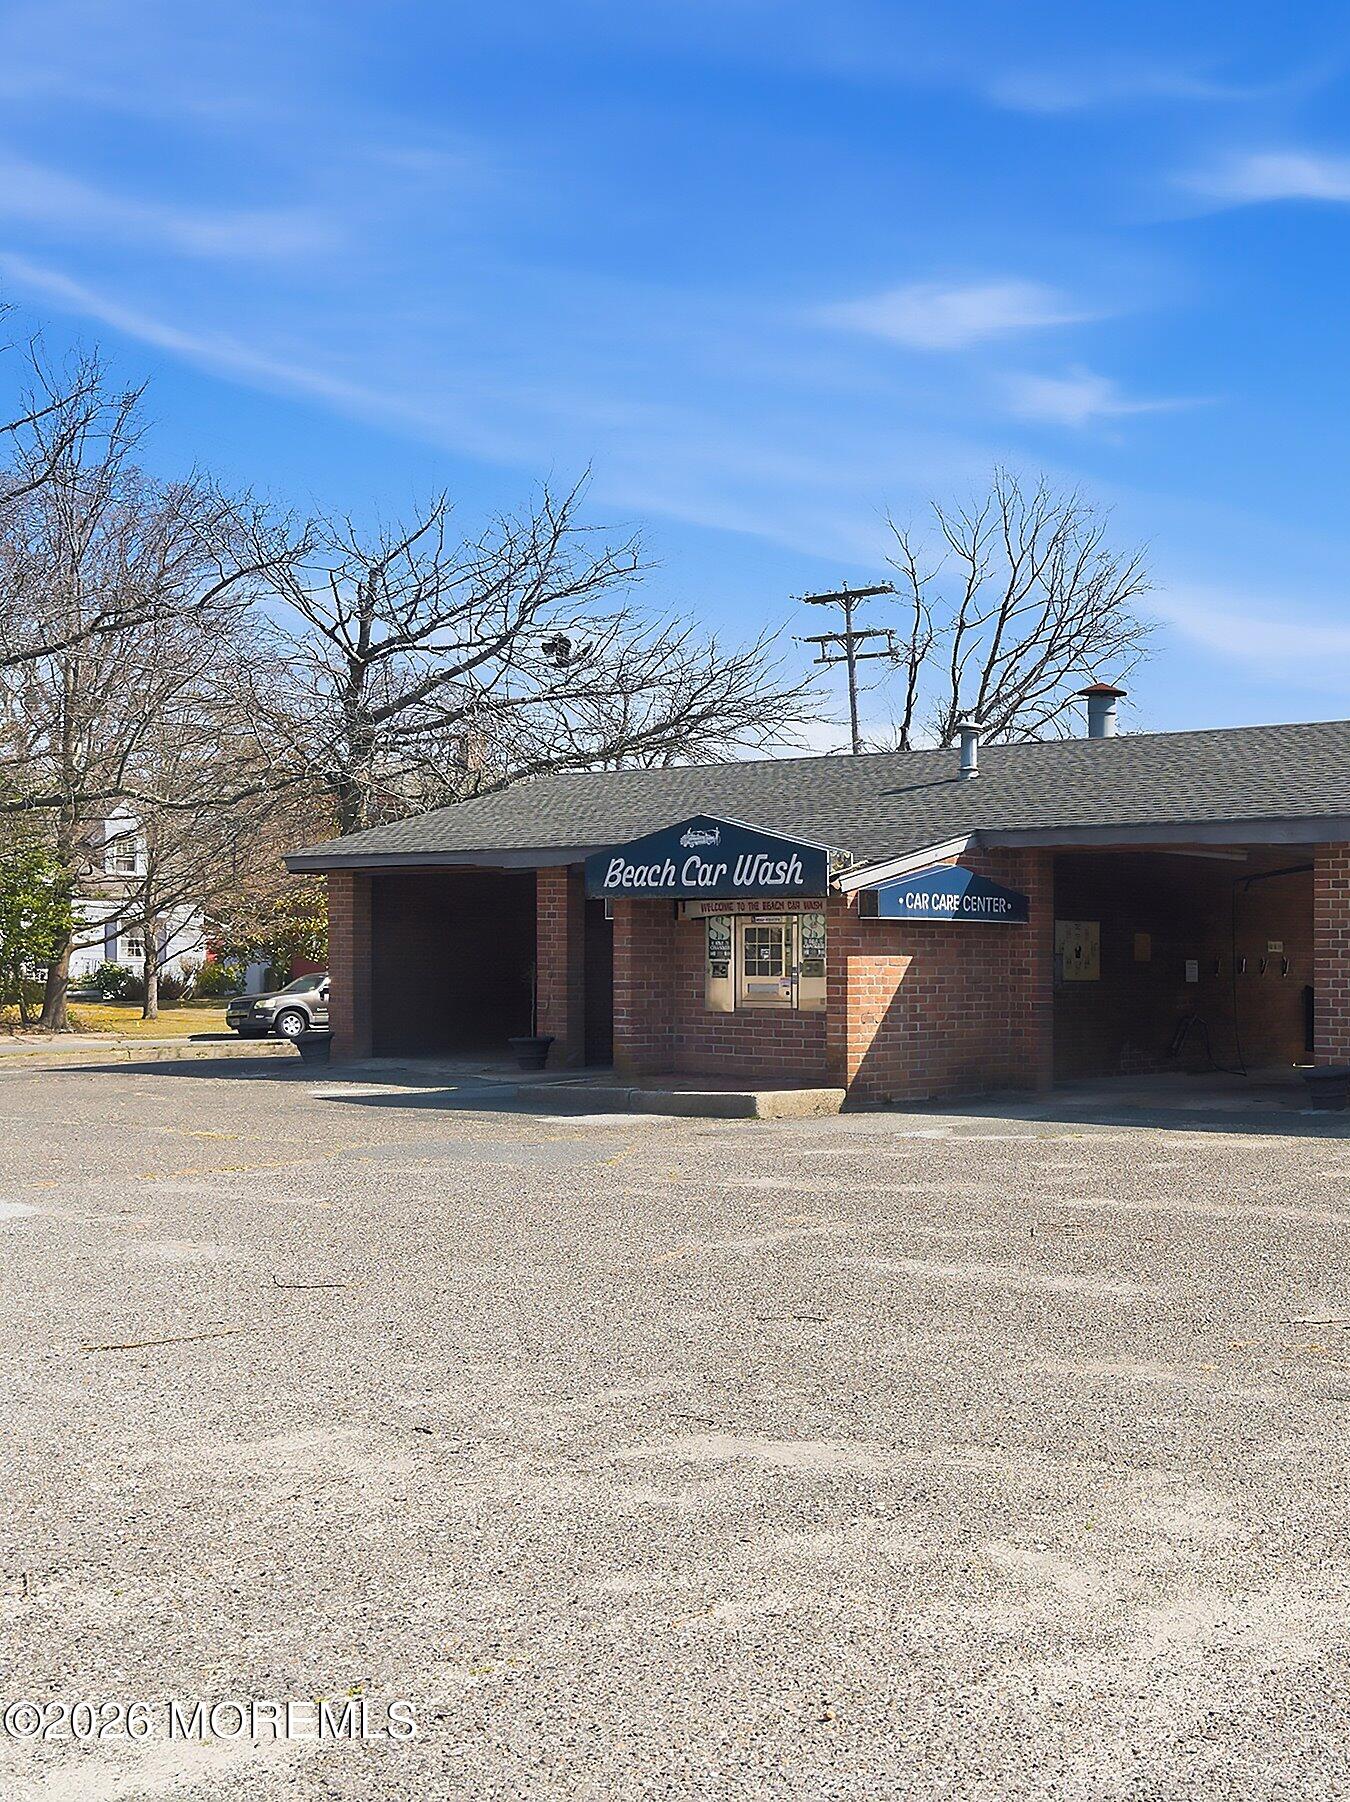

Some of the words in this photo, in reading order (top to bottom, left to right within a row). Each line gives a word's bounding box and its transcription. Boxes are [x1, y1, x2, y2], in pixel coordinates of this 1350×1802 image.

[603, 857, 676, 888] Beach
[681, 855, 727, 887] Car
[732, 853, 804, 886] Wash
[737, 902, 745, 911] TO
[905, 892, 929, 910] CAR
[931, 893, 960, 911] CARE
[963, 895, 1006, 913] CENTER
